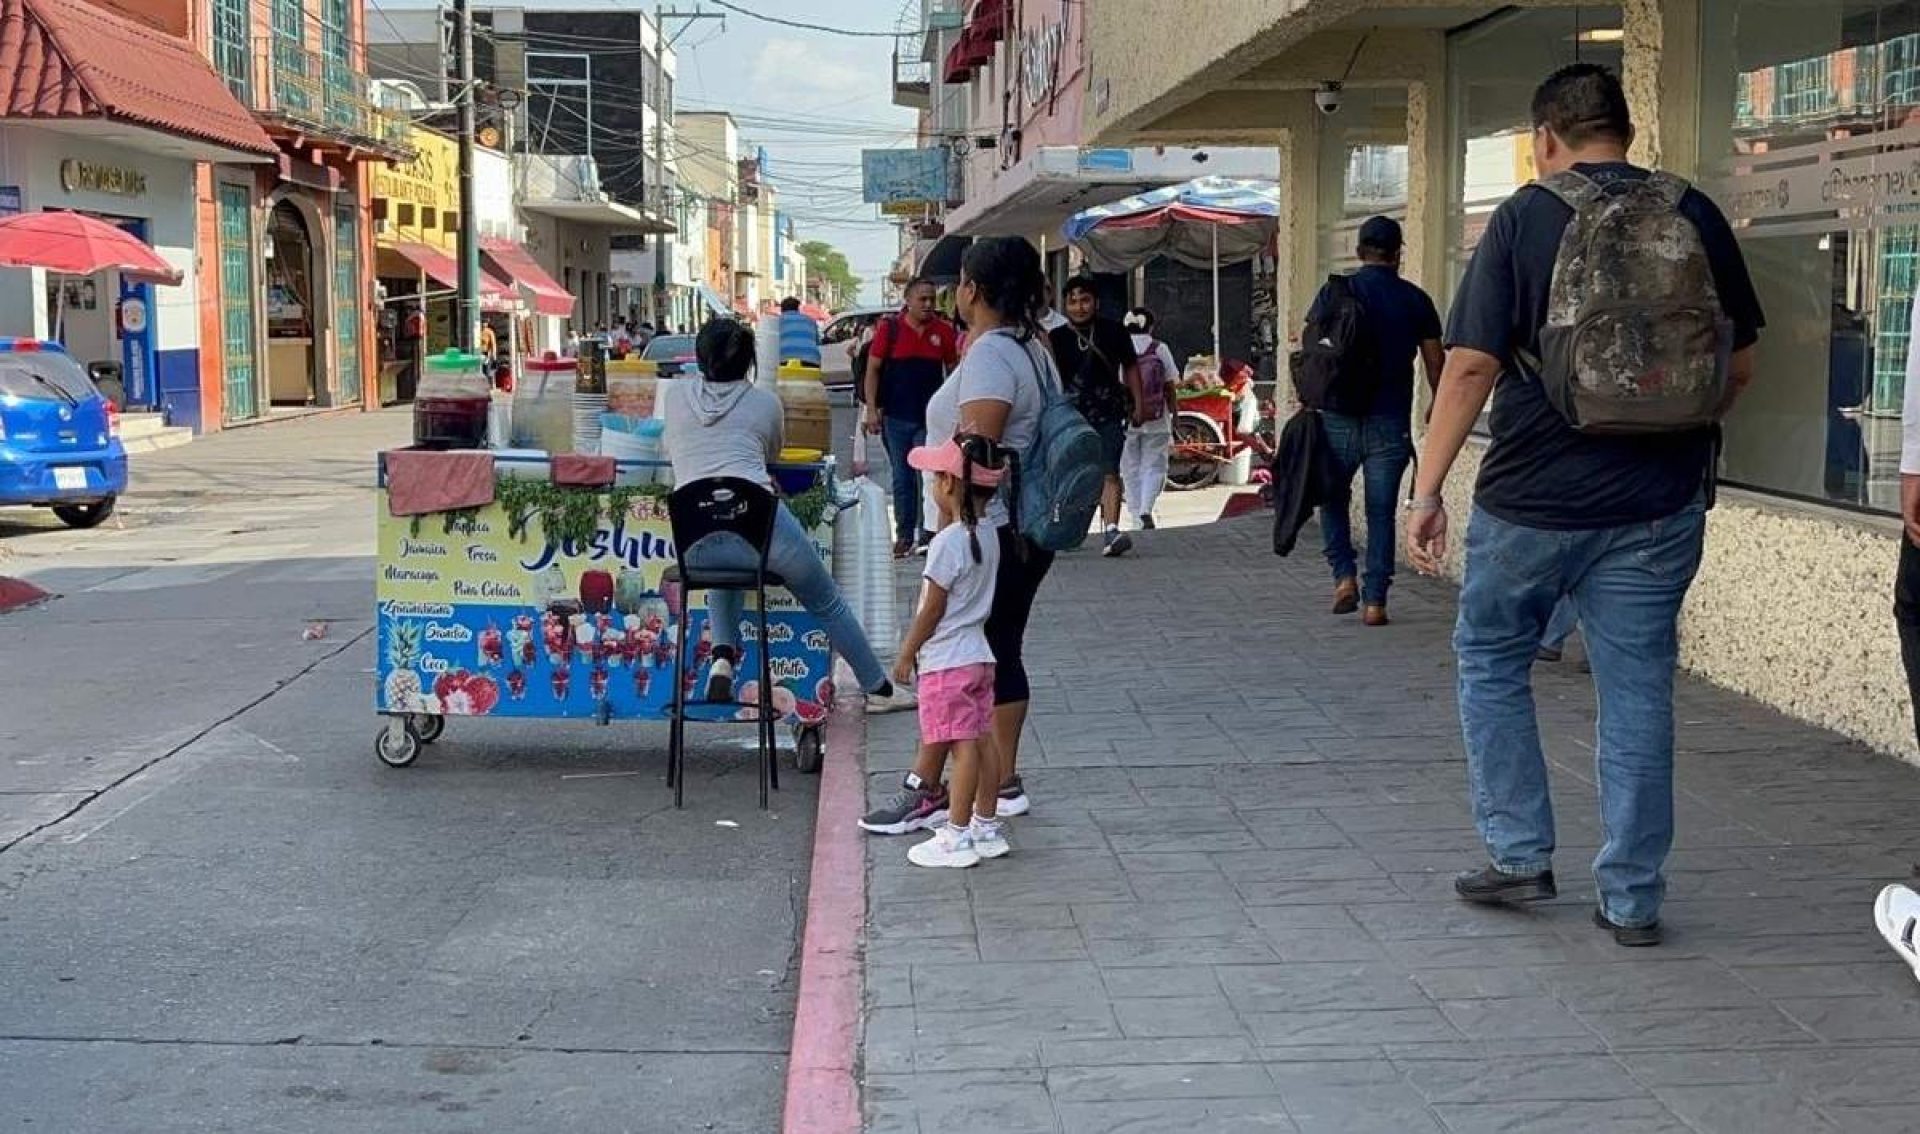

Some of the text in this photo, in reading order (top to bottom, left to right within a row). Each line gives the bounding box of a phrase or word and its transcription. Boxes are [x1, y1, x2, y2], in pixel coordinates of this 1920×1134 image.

[519, 506, 676, 570] Joshu
[467, 546, 497, 562] Fresa
[481, 580, 521, 597] Colada
[422, 655, 445, 670] Coco
